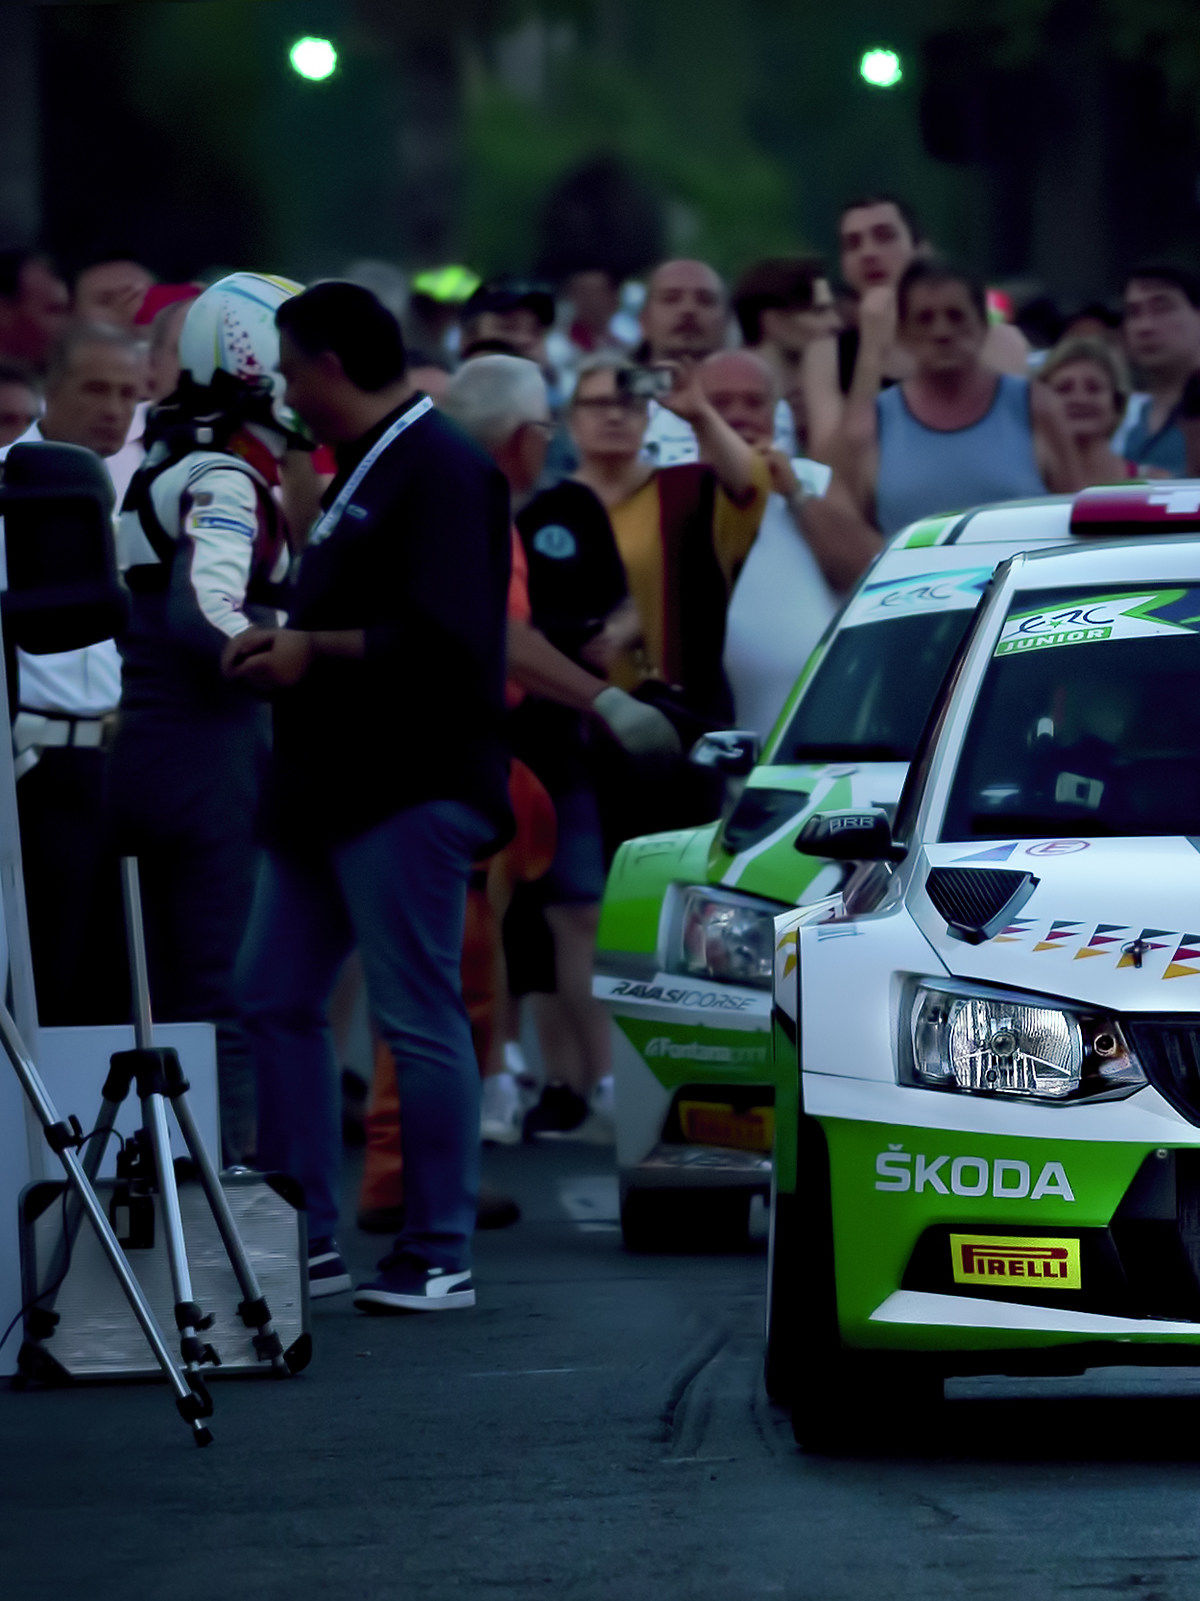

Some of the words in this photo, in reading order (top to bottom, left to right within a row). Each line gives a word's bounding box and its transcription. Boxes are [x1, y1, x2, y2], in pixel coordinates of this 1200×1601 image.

[1004, 628, 1106, 653] JUNIOR
[875, 1143, 1076, 1202] ŠKODA
[961, 1244, 1069, 1279] PIRELLI
